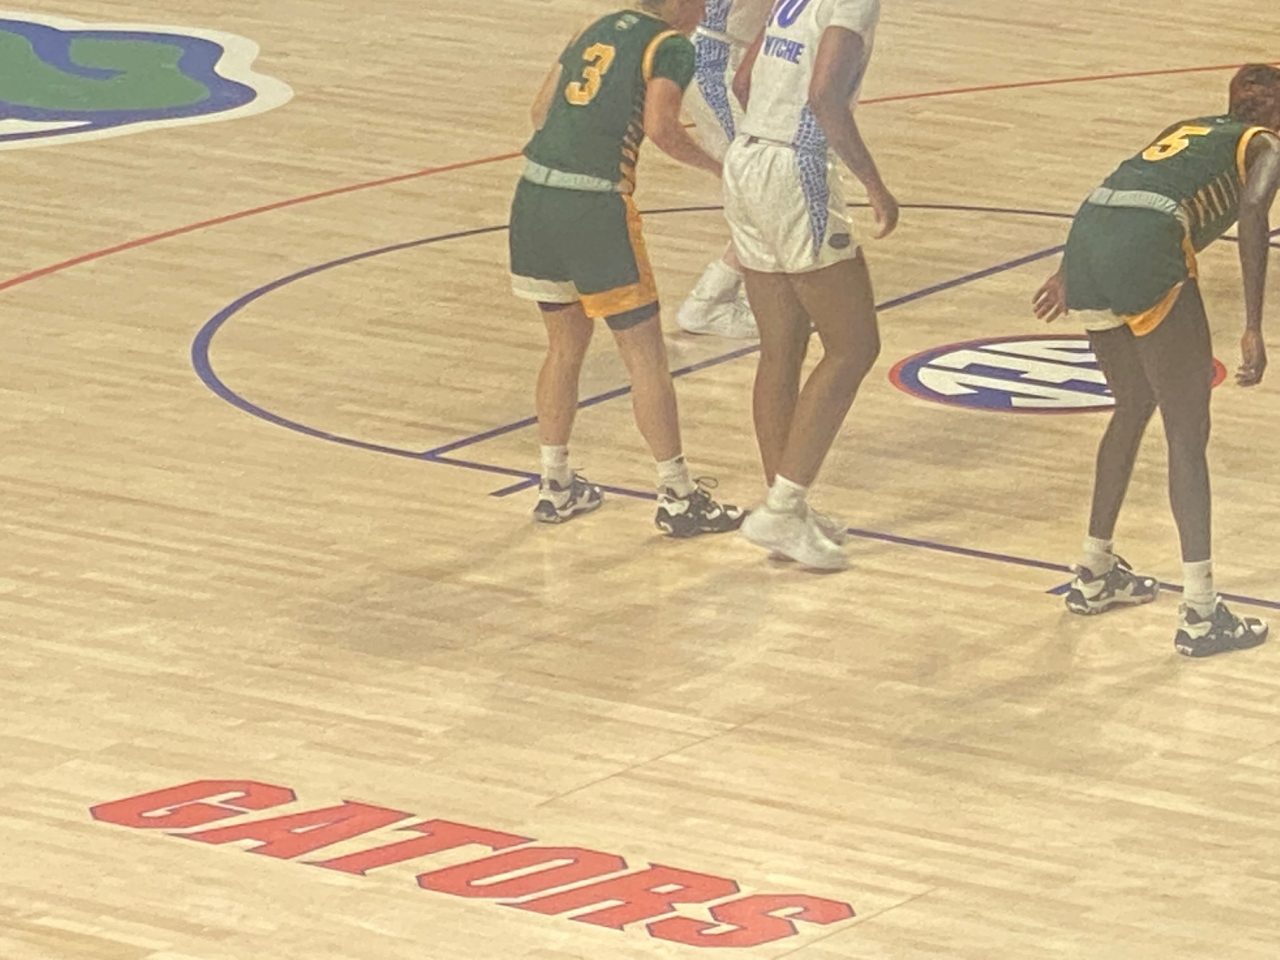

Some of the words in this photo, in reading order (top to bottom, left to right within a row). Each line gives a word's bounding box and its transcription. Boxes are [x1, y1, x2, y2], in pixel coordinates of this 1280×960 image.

[565, 42, 615, 106] 3
[1142, 125, 1213, 161] 5
[89, 779, 856, 948] GATORS
